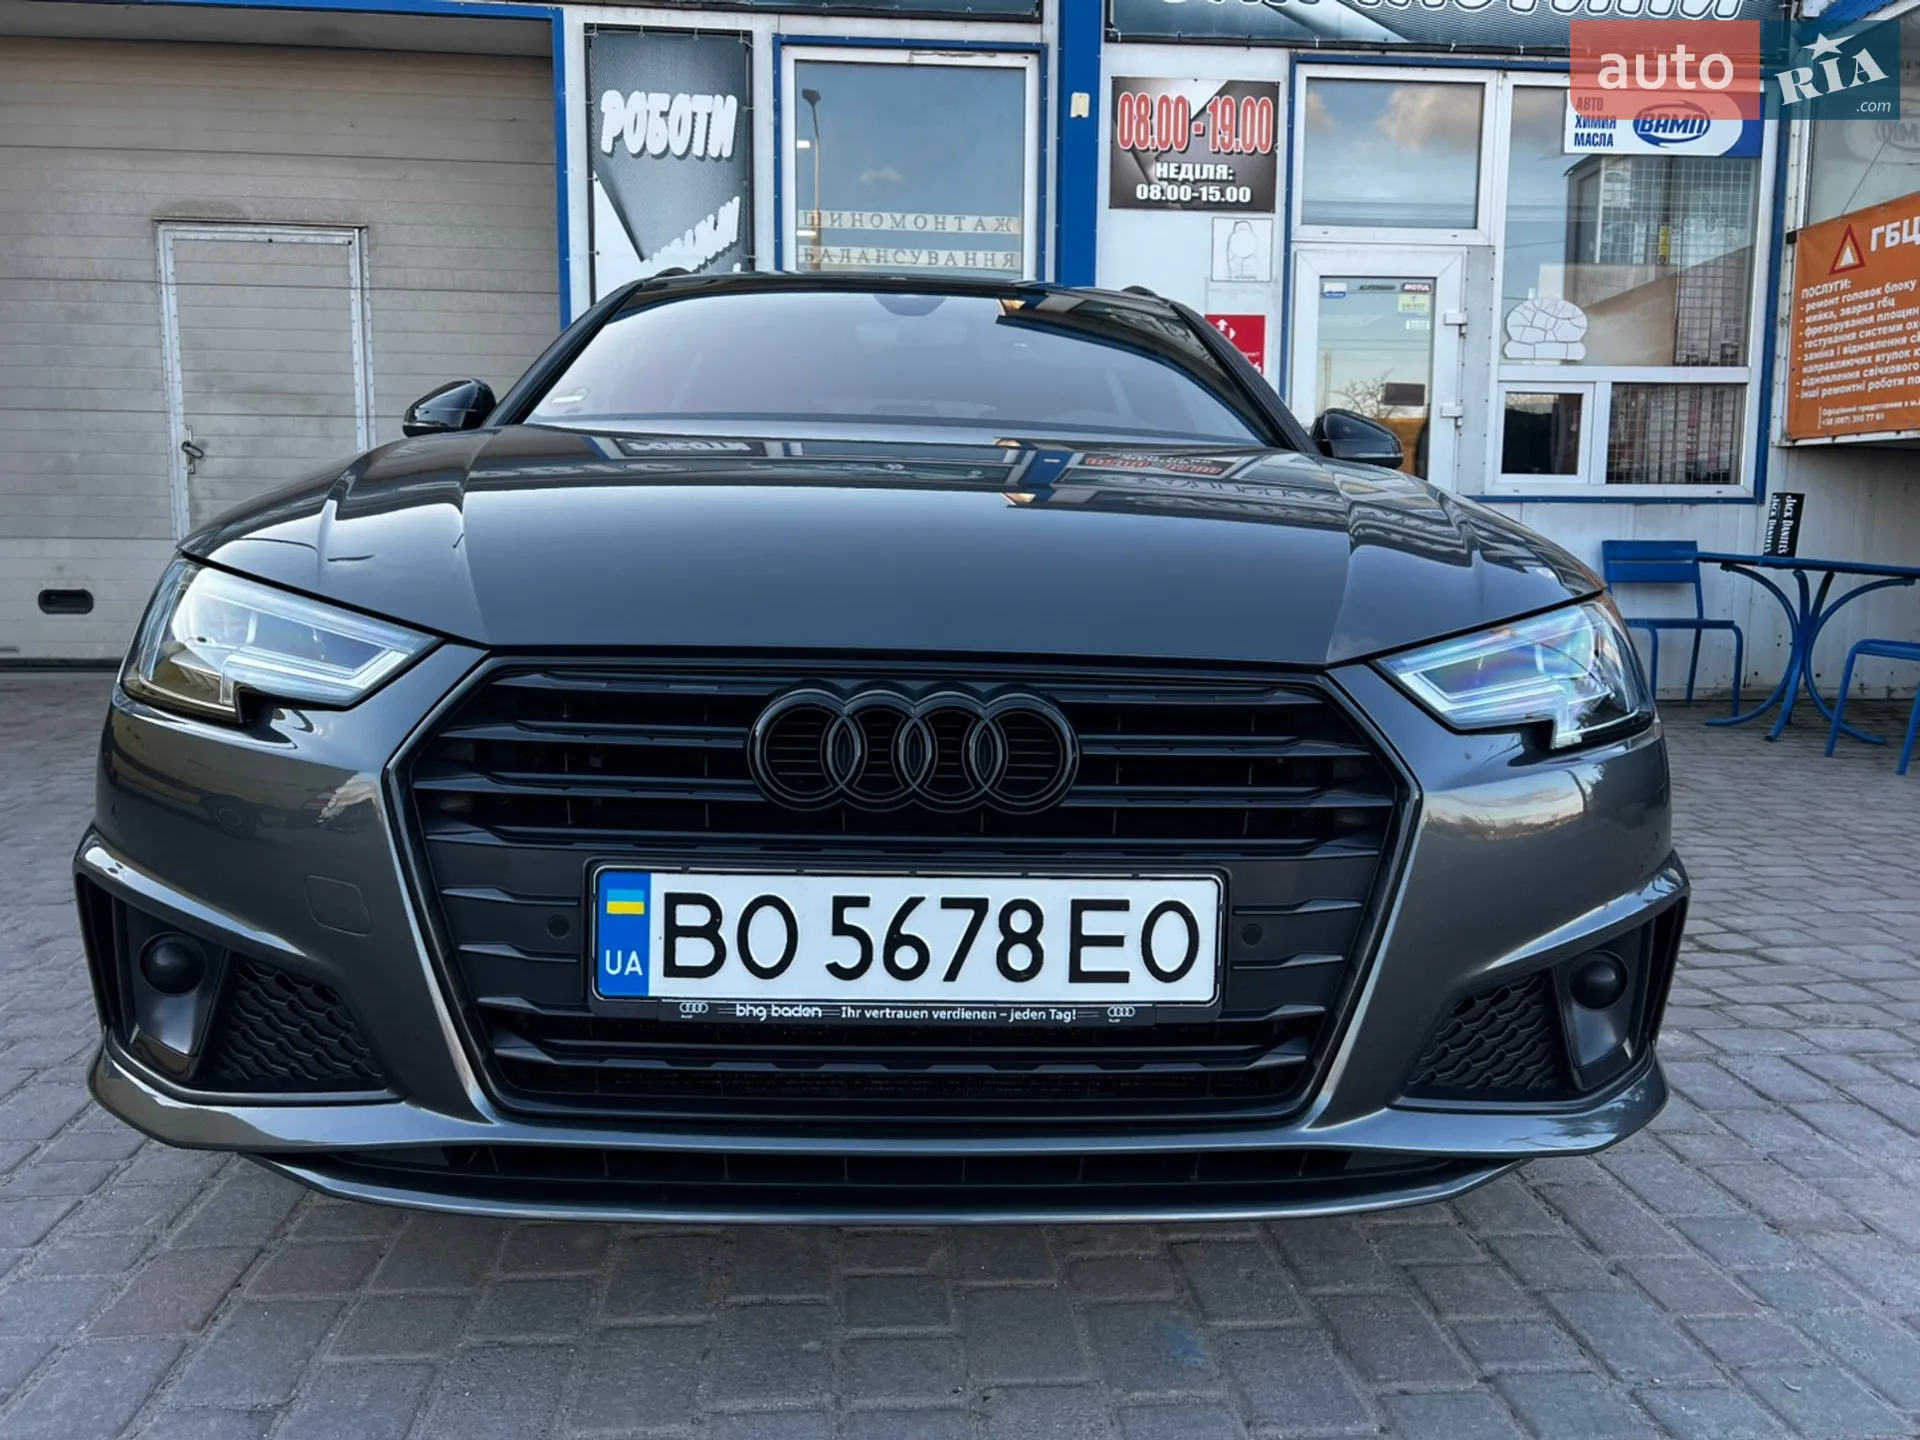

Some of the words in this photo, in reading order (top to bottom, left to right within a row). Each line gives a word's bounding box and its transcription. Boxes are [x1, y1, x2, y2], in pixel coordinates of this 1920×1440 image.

[1576, 96, 1604, 111] АВТО
[601, 89, 738, 158] РОБОТИ
[1575, 114, 1617, 129] ХИМИЯ
[1638, 112, 1705, 135] ВАМП
[1574, 132, 1614, 147] МАСЛА
[1155, 162, 1234, 181] НЕДІЛЯ:
[1136, 184, 1251, 202] 08.00-15.00
[804, 212, 1013, 233] ШИНОМОНТАЖ
[1870, 216, 1920, 252] ГБЦ
[804, 248, 1016, 268] БАЛАНСУВАННЯ
[1801, 278, 1852, 299] ПОСЛУГИ:
[1805, 297, 1840, 313] ремонт
[1842, 286, 1882, 304] головок
[1884, 279, 1918, 294] блоку
[1840, 302, 1875, 316] зварка
[1877, 297, 1896, 310] гбц
[1877, 307, 1920, 322] площин
[1804, 331, 1857, 349] тестування
[1858, 323, 1903, 339] системи
[1905, 320, 1920, 330] ох
[1842, 336, 1908, 355] відновлення
[1875, 349, 1911, 364] втулок
[1862, 361, 1920, 378] свічкового
[1821, 380, 1866, 399] ремонтні
[1868, 377, 1905, 392] роботи
[663, 891, 799, 980] BO
[825, 894, 1045, 983] 5678
[1068, 898, 1200, 984] EO
[604, 949, 643, 977] UA
[735, 1004, 767, 1022] bhg
[771, 1004, 822, 1018] baden
[841, 1006, 861, 1019] Ihr
[864, 1006, 928, 1020] vertrauen
[932, 1007, 997, 1020] verdienen
[1009, 1007, 1047, 1023] jeden
[1049, 1009, 1077, 1023] Tag!
